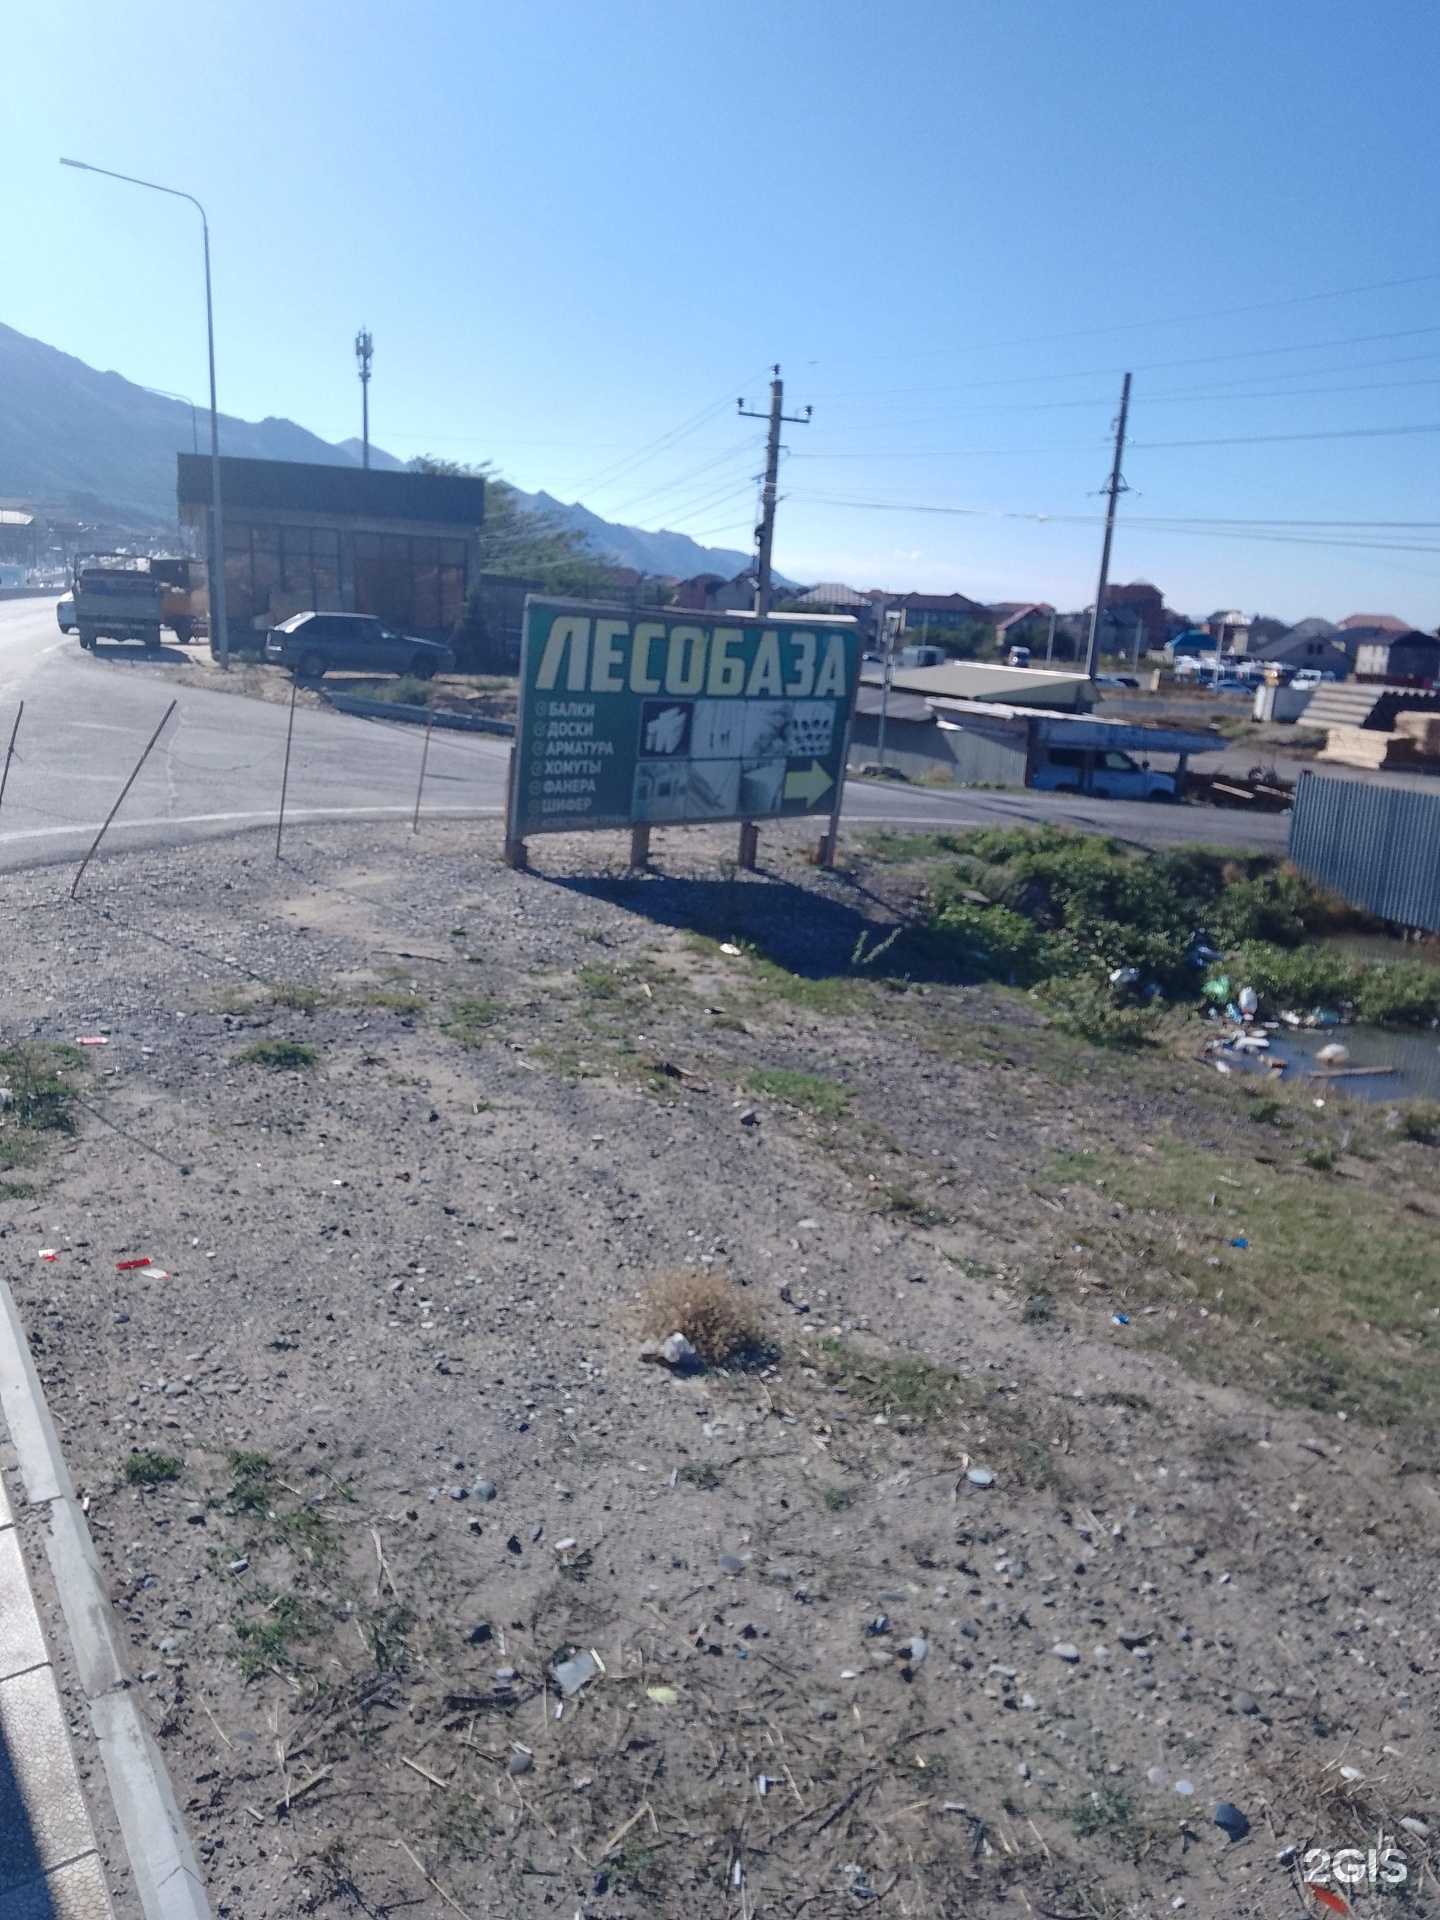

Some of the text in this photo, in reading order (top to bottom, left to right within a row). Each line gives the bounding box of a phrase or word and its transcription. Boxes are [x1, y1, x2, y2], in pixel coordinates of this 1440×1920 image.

[535, 615, 847, 697] ЛЕСОБАЗА
[548, 701, 596, 718] БАЛКИ
[547, 721, 594, 739] ДОСКИ
[545, 740, 615, 757] АРМАТУРА
[544, 759, 602, 775] ХОМУТЫ
[543, 779, 597, 794] ФАНЕРА
[542, 797, 593, 814] ШИФЕР
